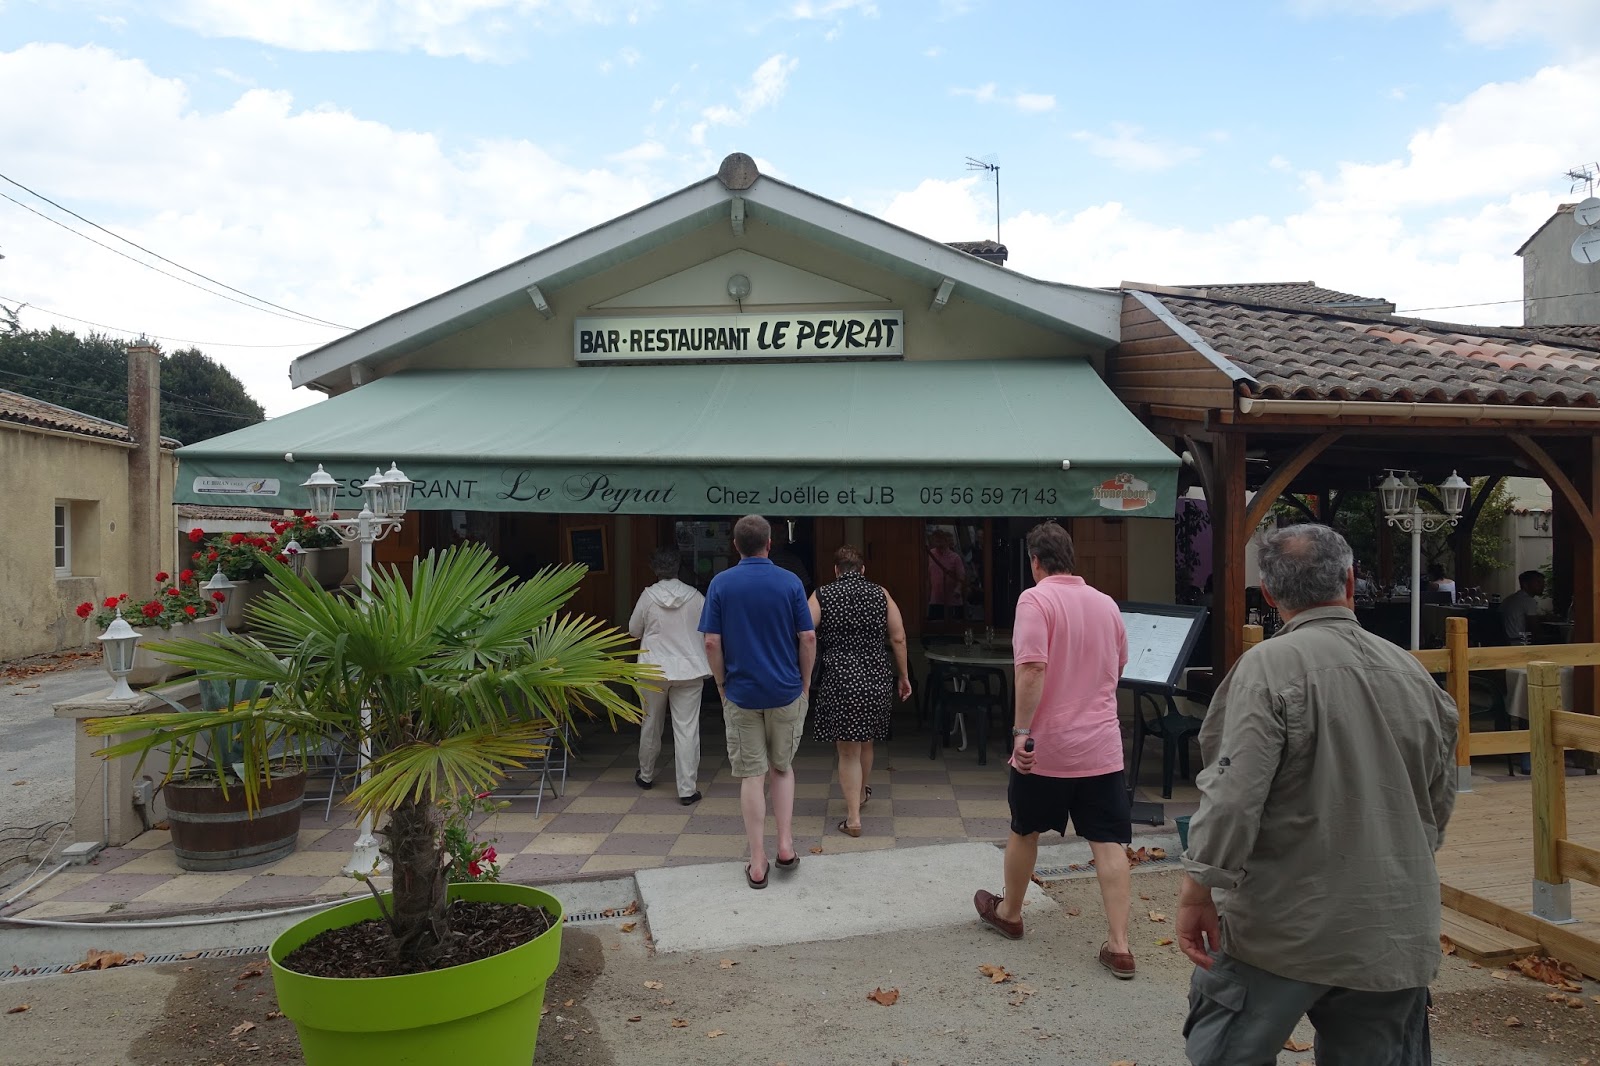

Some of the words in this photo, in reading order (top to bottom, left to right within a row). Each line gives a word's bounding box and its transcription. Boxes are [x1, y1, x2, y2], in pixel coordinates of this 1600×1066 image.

[756, 321, 791, 350] LE
[796, 318, 899, 350] PEYRAT
[496, 468, 554, 501] Le
[562, 471, 678, 513] Peyrat
[706, 486, 760, 504] Chez
[768, 486, 829, 504] Joëlle
[837, 487, 856, 504] et
[863, 486, 895, 505] J.B
[920, 487, 943, 505] 05
[950, 487, 974, 505] 56
[980, 487, 1004, 505] 59
[1010, 488, 1028, 504] 71
[1034, 488, 1057, 505] 43
